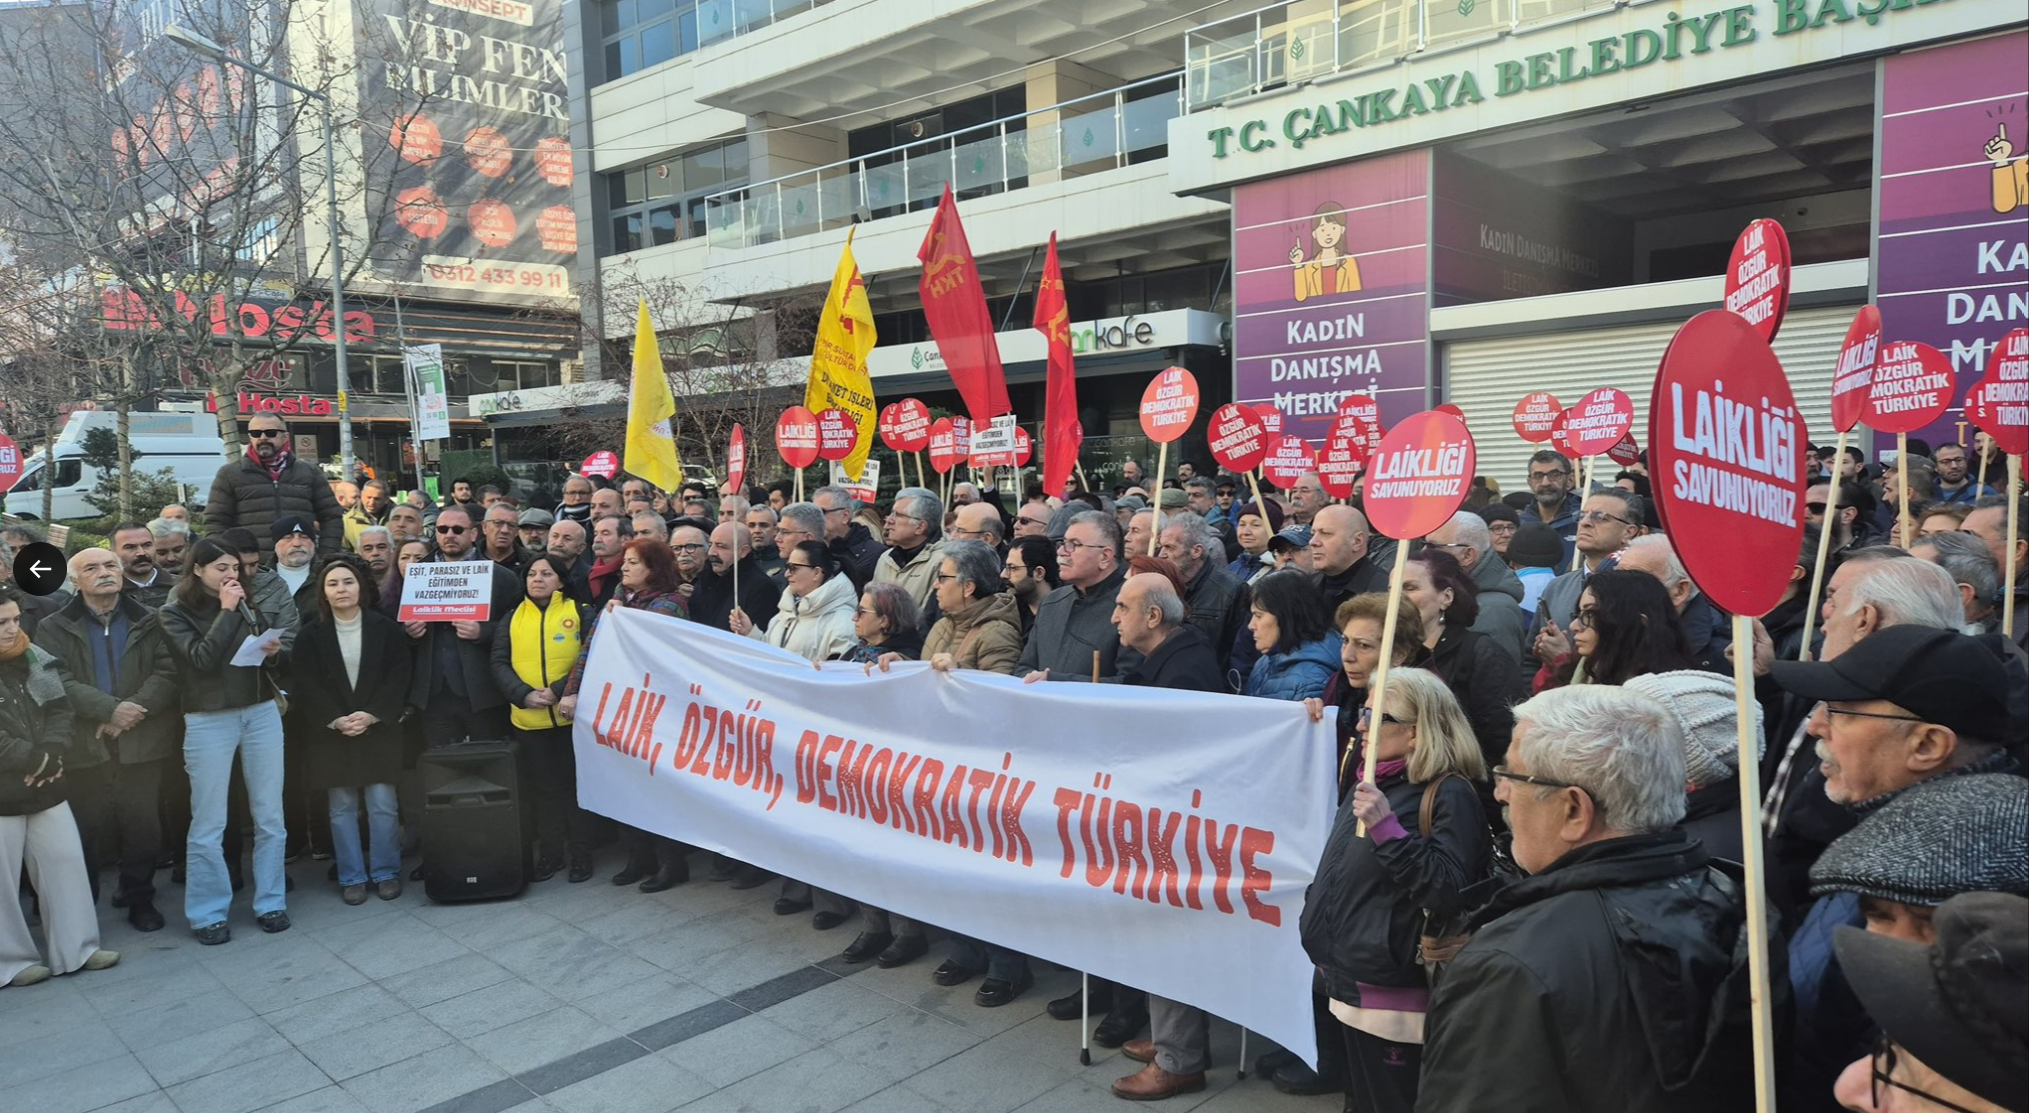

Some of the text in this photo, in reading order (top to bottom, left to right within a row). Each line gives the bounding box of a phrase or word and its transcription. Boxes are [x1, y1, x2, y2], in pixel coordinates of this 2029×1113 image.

[480, 36, 567, 87] FEN
[1283, 70, 1485, 149] ÇANKAYA
[1494, 4, 1757, 97] BELEDİYE
[1480, 223, 1515, 255] KADIN
[1743, 223, 1764, 256] LAİK
[430, 265, 562, 288] 0312 433 99 11
[1738, 249, 1767, 285] ÖZGÜR
[1727, 262, 1780, 312] DEMOKRATİK
[1071, 315, 1153, 353] ankafe
[1287, 313, 1364, 344] KADIN
[1836, 329, 1879, 378] LAİKLİĞİ
[1883, 343, 1918, 363] LAİK
[1163, 368, 1183, 384] LAİK
[1271, 349, 1382, 384] DANIŞMA
[1875, 361, 1924, 382] ÖZGÜR
[1156, 384, 1183, 399] ÖZGÜR
[1833, 368, 1873, 397] SAVUNUYORUZ
[1870, 372, 1949, 398] MOKRATİK
[238, 392, 331, 414] Hosta
[1142, 394, 1195, 414] DEMOKRATİK
[1274, 377, 1379, 415] MERKİ
[1532, 394, 1549, 403] LAİK
[1593, 388, 1616, 403] LAİK
[1872, 390, 1939, 414] TÜRKİYE
[825, 410, 841, 420] LAİK
[1152, 409, 1187, 426] TÜRKİYE
[1219, 404, 1241, 422] LAİK
[1340, 403, 1377, 416] LAİKLİĞİ
[1526, 403, 1550, 412] ÖZGÜR
[1585, 402, 1615, 417] ÖZGÜR
[779, 421, 817, 439] LAİKLİĞİ
[1218, 417, 1246, 436] ÖZGÜR
[1568, 411, 1629, 430] DEMOKRATİK
[1211, 423, 1262, 453] DEMOKRATİK
[1580, 425, 1618, 441] TÜRKİYE
[1671, 379, 1796, 483] LAİKLİĞİ
[1225, 439, 1261, 460] TÜRKİYE
[1283, 437, 1302, 448] LAİK
[1333, 436, 1349, 449] LAİK
[1264, 456, 1313, 468] DEMOKRATİK
[1277, 448, 1302, 458] ÖZGÜR
[1329, 449, 1351, 462] ÖZGÜR
[1374, 439, 1467, 479] LAİKLİĞİ
[1318, 459, 1362, 473] DEMOKRATİK
[1370, 478, 1461, 498] SAVUNUYORUZ
[1673, 459, 1797, 528] SAVUNUYORUZ
[429, 566, 460, 576] PARASIZ
[462, 565, 471, 575] VE
[473, 563, 489, 575] LAİK
[428, 576, 469, 588] EĞİTİMDEN
[414, 588, 479, 602] VAZGEÇMİYORUZ!
[592, 672, 1282, 927] LAİK, ÖZGÜR, DEMOKRATİK TÜRKİYE
